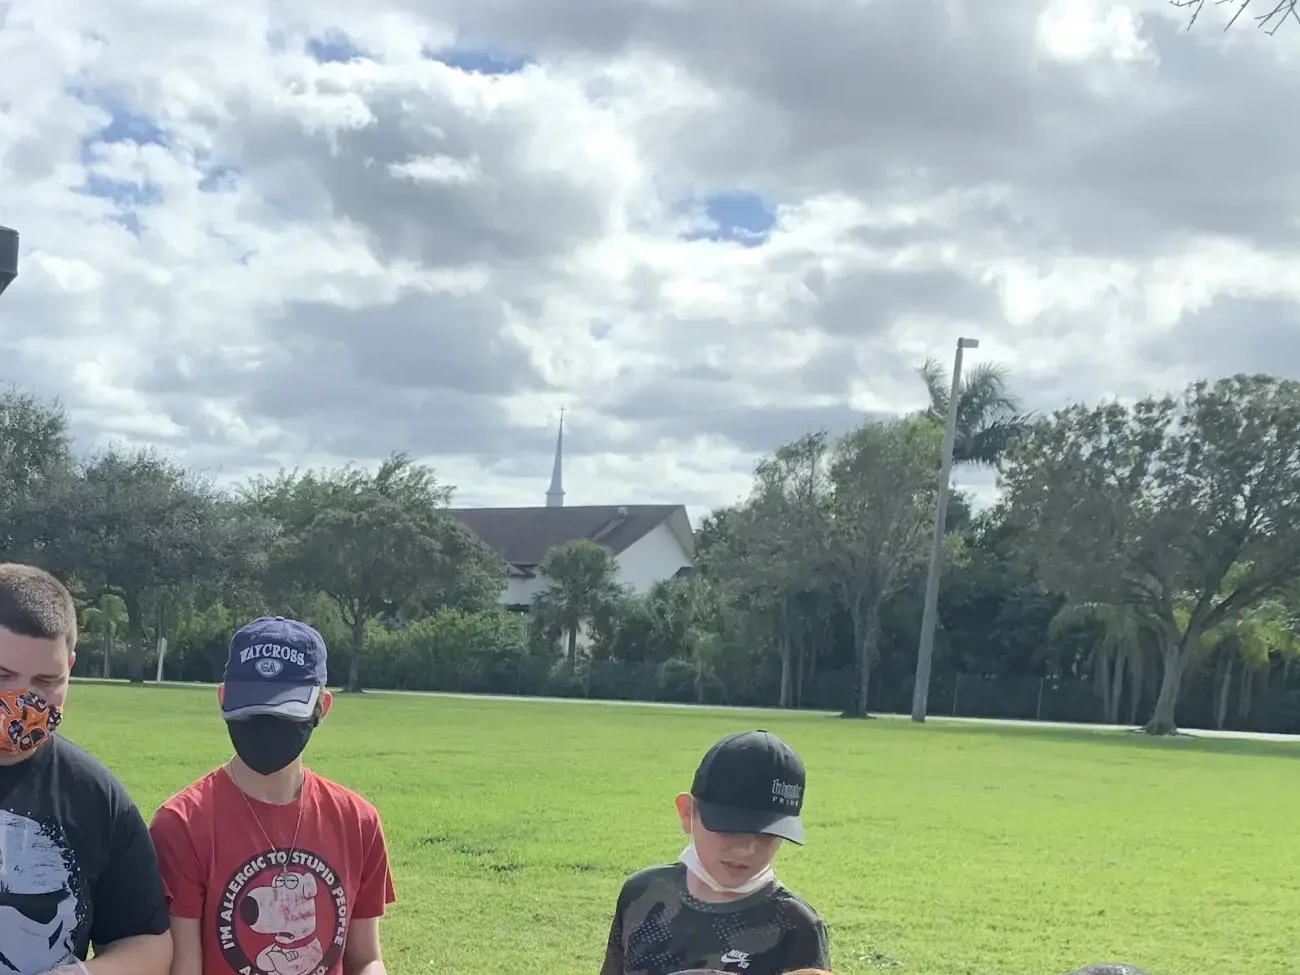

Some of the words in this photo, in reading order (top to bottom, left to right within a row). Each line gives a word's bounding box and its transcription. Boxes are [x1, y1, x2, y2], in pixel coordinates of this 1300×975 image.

[240, 644, 305, 665] WAYCROSS
[260, 661, 277, 673] GA
[267, 852, 287, 864] TO
[292, 851, 335, 886] STUPID
[221, 857, 266, 922] ALLERGIC
[332, 887, 347, 946] PEOPLE
[220, 926, 235, 950] I'M
[728, 949, 750, 959] NIKE
